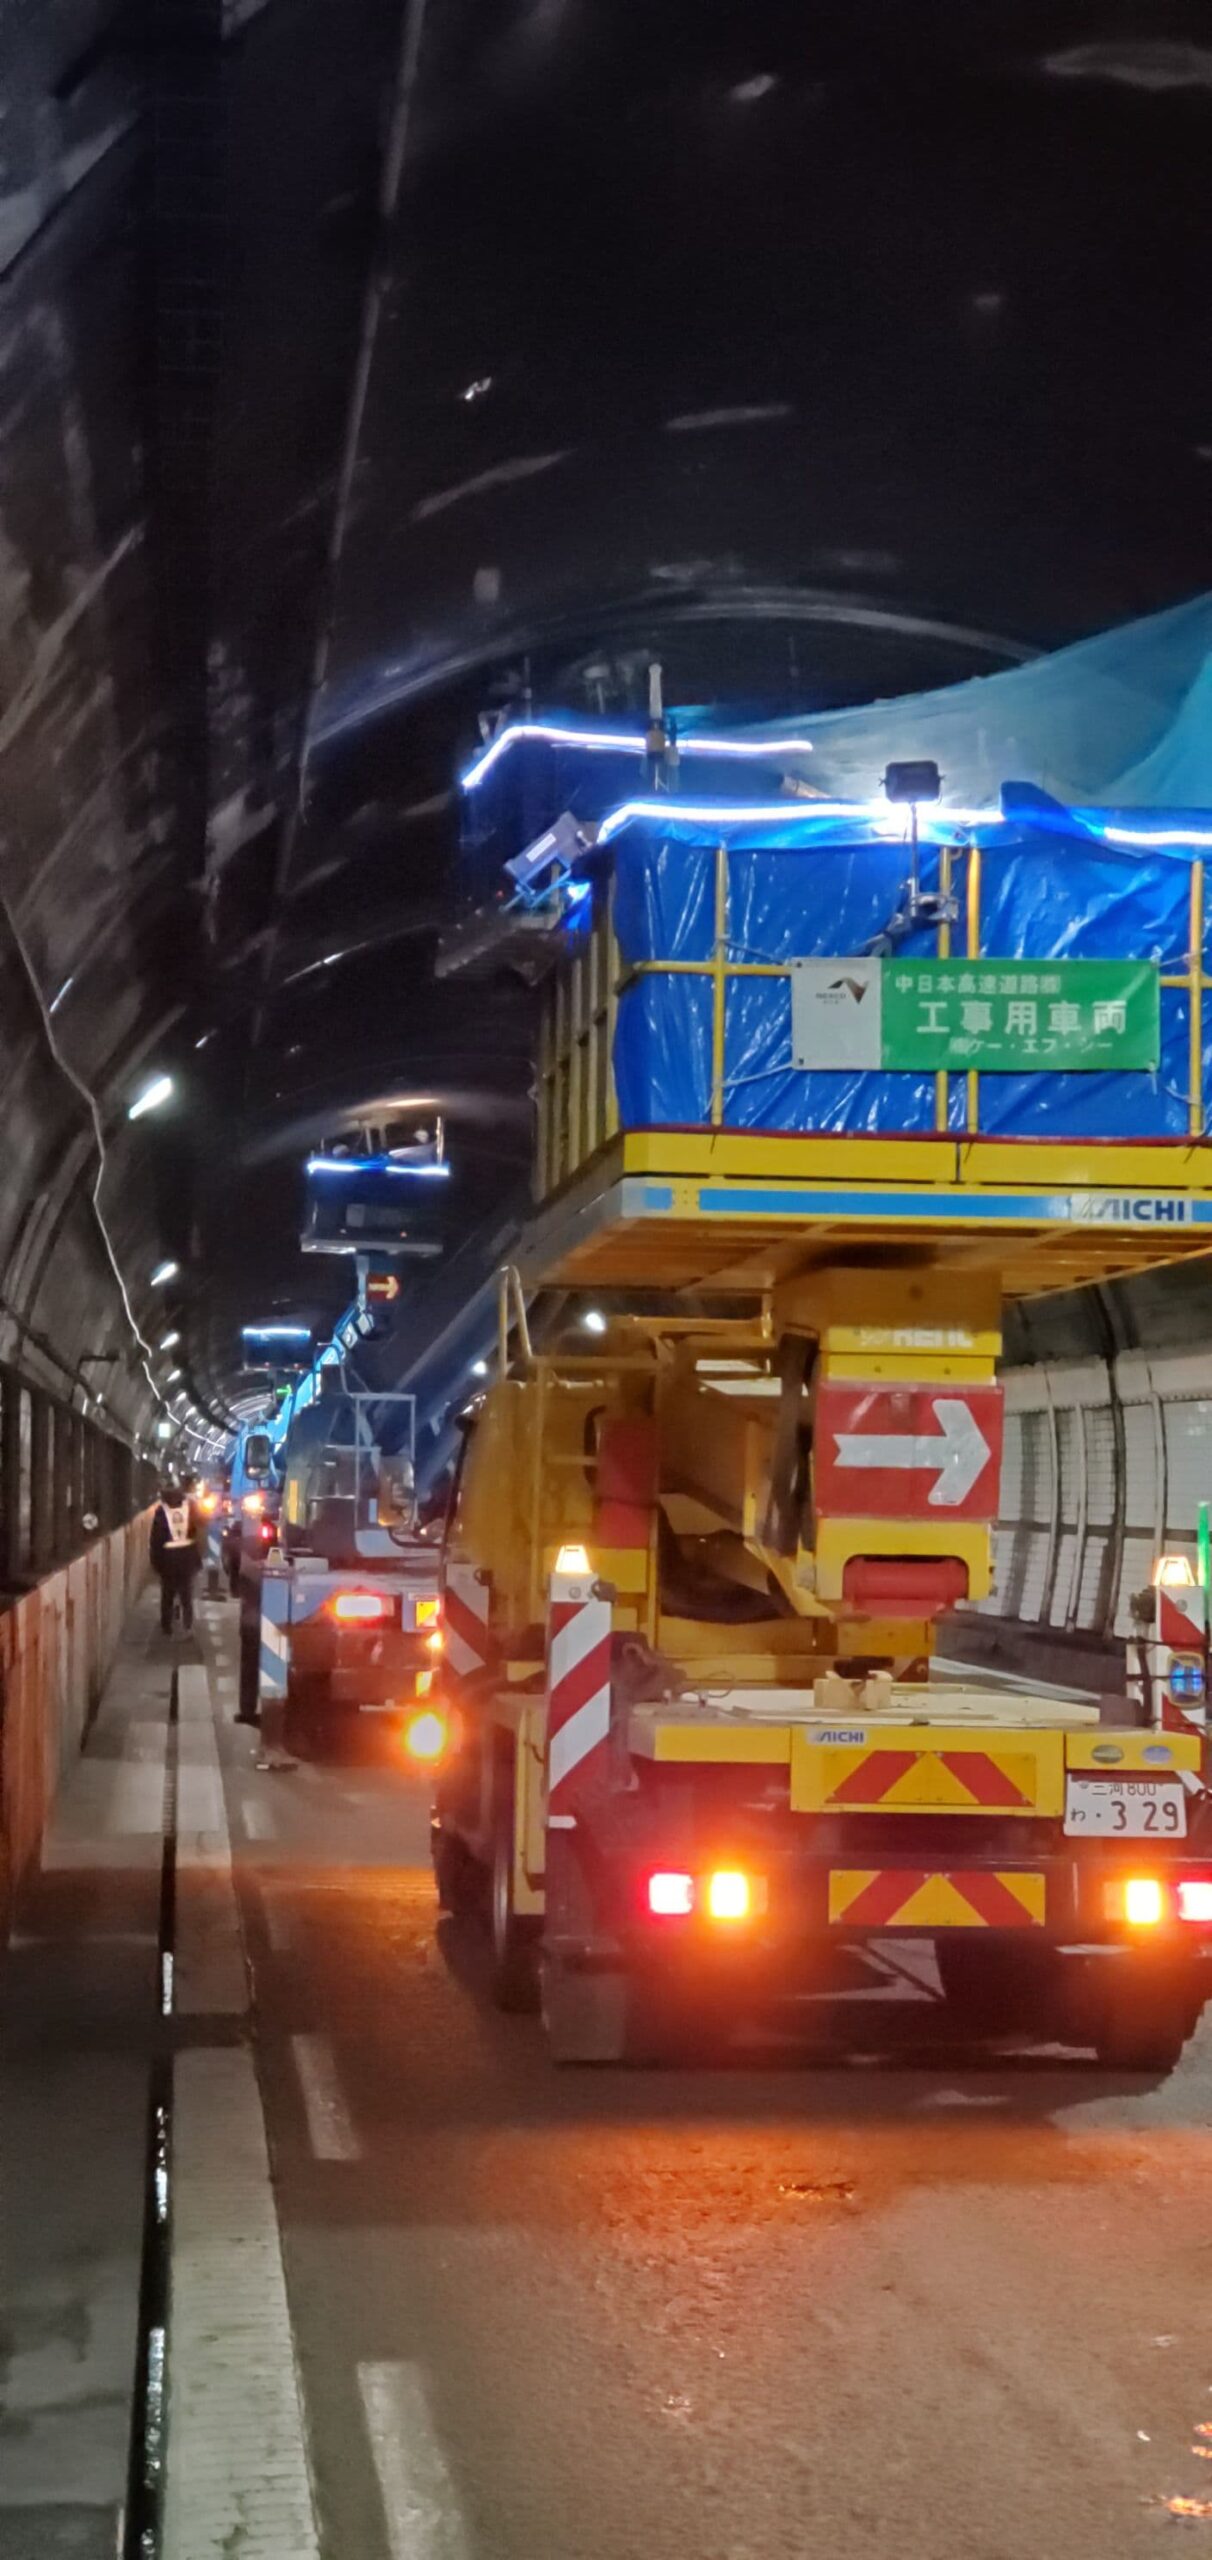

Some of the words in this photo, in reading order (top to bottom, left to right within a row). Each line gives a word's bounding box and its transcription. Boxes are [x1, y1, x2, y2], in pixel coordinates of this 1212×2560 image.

[916, 1001, 1127, 1035] 工事用車両
[1094, 1199, 1185, 1222] AICHI
[820, 1731, 864, 1743] AICHI
